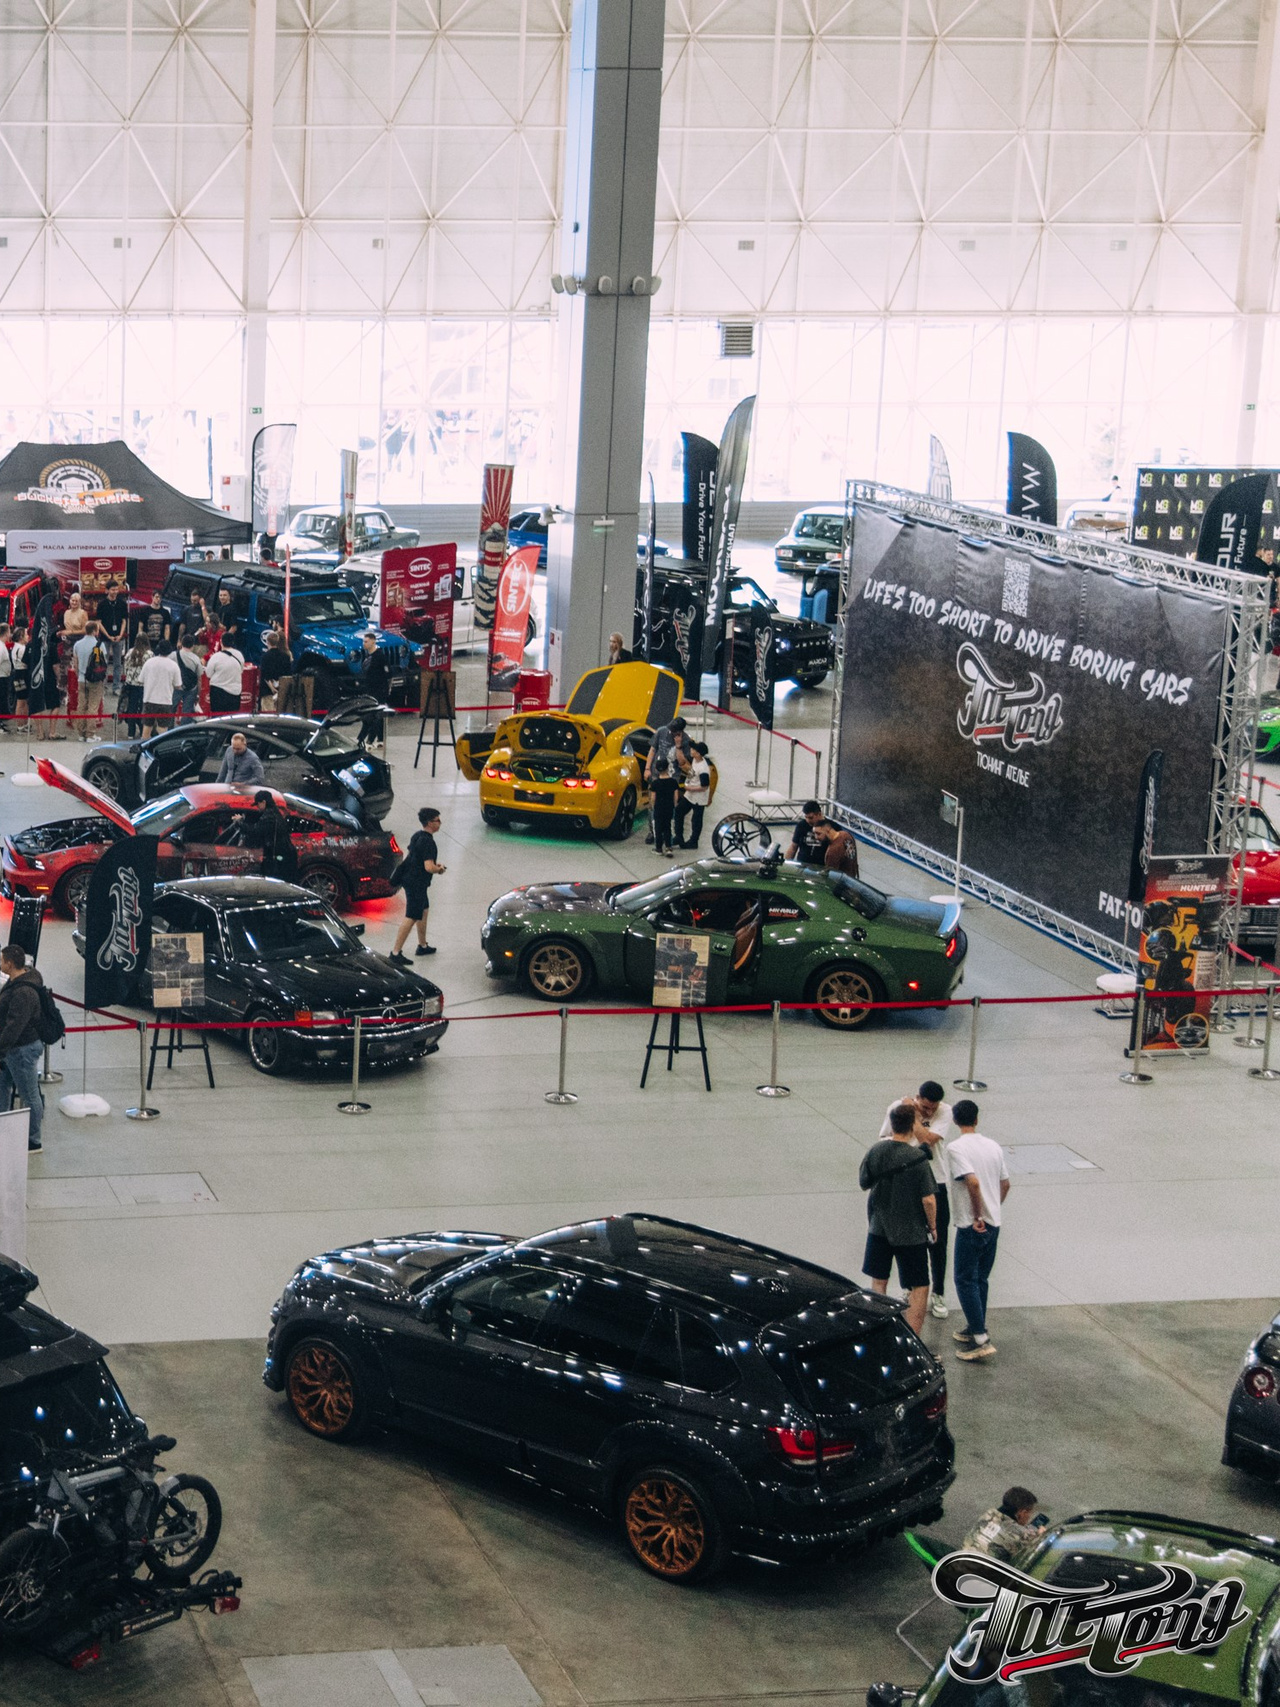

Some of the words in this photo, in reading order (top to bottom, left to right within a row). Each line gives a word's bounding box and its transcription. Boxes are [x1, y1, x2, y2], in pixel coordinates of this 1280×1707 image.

[698, 534, 706, 562] Futur
[1234, 528, 1248, 564] Future
[409, 563, 431, 572] SINTEC
[506, 563, 523, 613] SINTEC
[863, 578, 906, 610] LIFE'S
[909, 590, 936, 618] TOO
[937, 600, 991, 637] SHORT
[993, 618, 1013, 644] TO
[1014, 628, 1066, 662] DRIVE
[1069, 645, 1136, 690] BORING
[1140, 668, 1193, 706] CARS
[976, 750, 1005, 776] ТЮНИНГ
[1005, 763, 1030, 788] АТЕЛЬЕ
[1180, 884, 1218, 892] HUNTER
